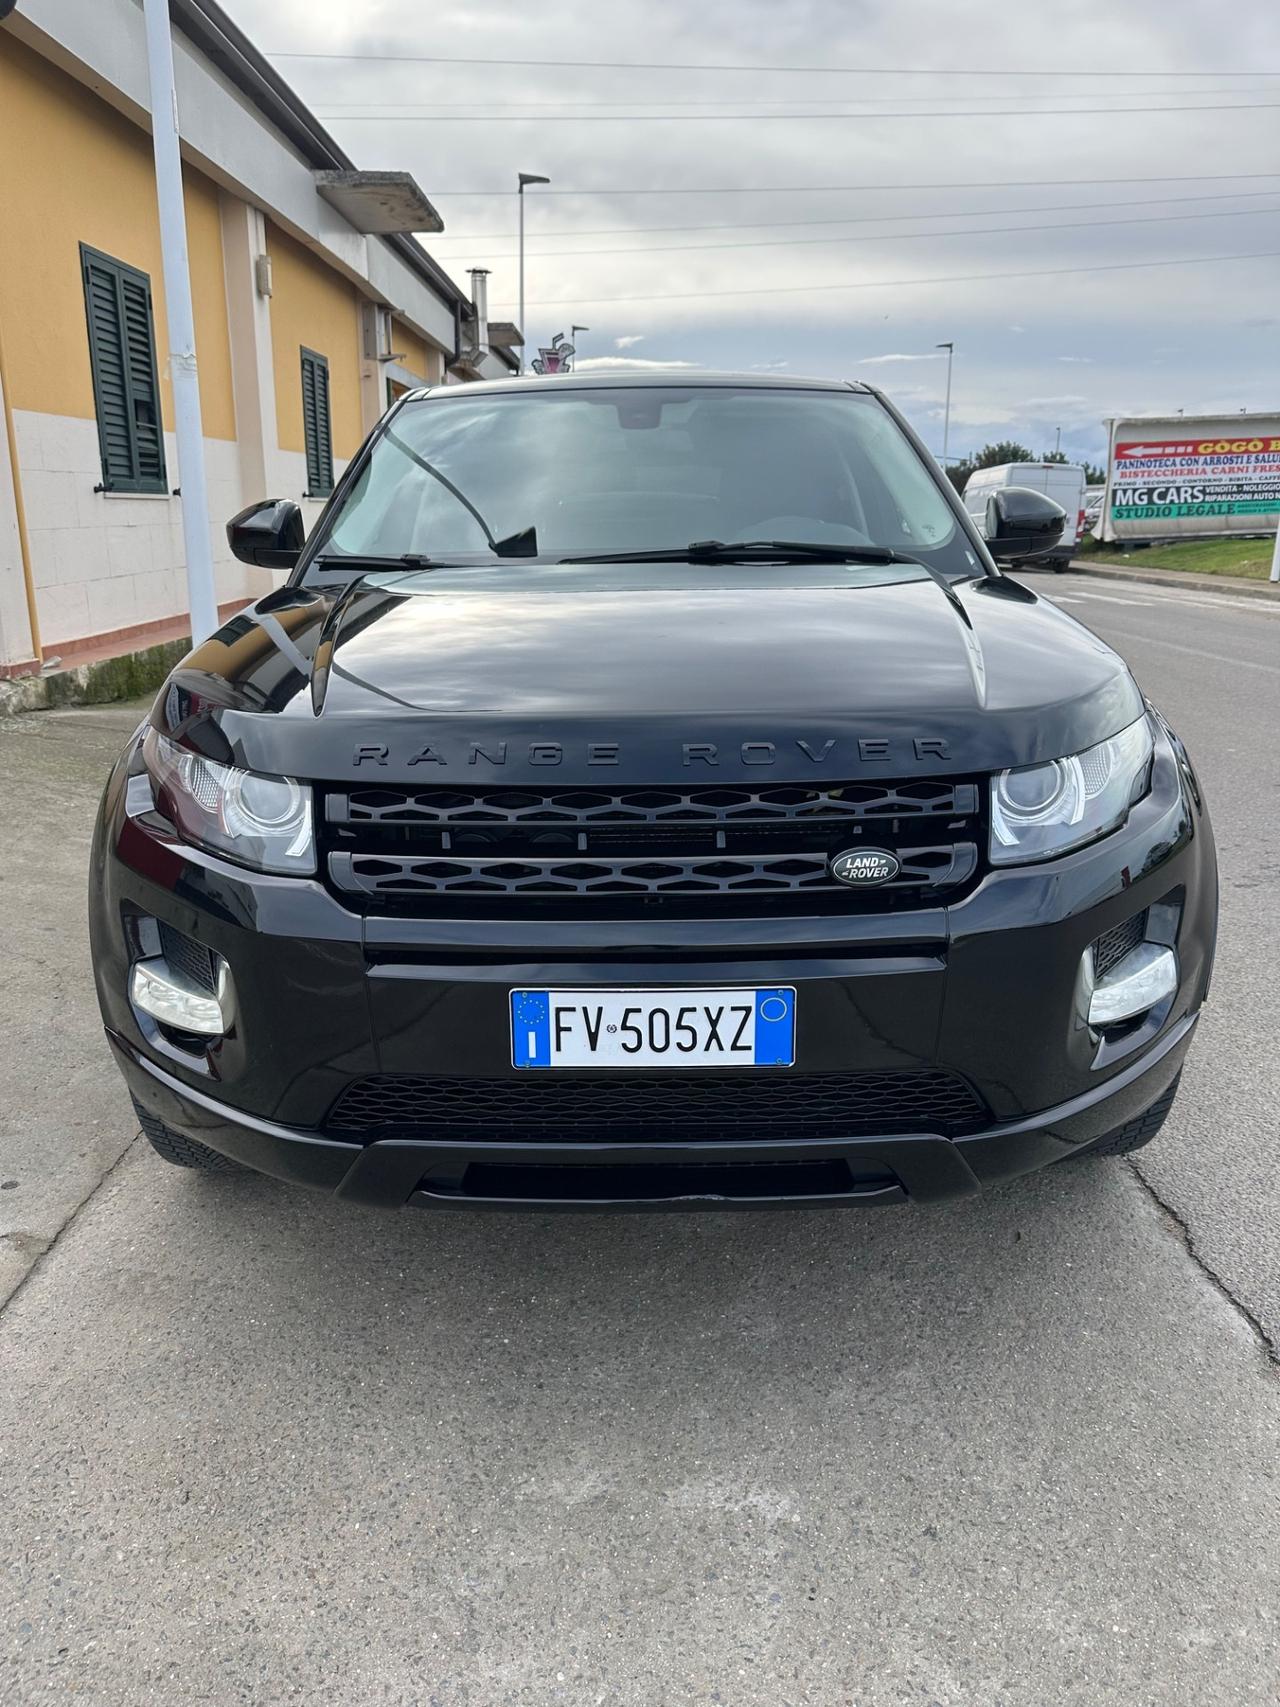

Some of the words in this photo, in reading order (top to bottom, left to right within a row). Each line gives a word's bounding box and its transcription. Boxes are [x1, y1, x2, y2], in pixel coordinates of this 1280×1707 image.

[1116, 459, 1177, 470] PANINOTECA
[1179, 458, 1199, 468] CON
[1201, 455, 1243, 466] ARROSTI
[1246, 455, 1252, 464] E
[1119, 467, 1207, 479] BISTECCHERIA
[1211, 466, 1249, 475] CARNI
[1205, 485, 1238, 493] VENDITA
[1243, 483, 1280, 491] NOLEGGIO
[1115, 488, 1148, 506] MG
[1152, 486, 1204, 505] CARS
[1204, 494, 1253, 502] RIPARAZIONI
[1253, 492, 1275, 500] AUTO
[1115, 505, 1172, 519] STUDIO
[1175, 503, 1236, 517] LEGALE
[353, 742, 620, 768] RANGE
[682, 738, 952, 766] ROVER
[846, 857, 879, 868] LAND
[849, 867, 889, 879] ROVER
